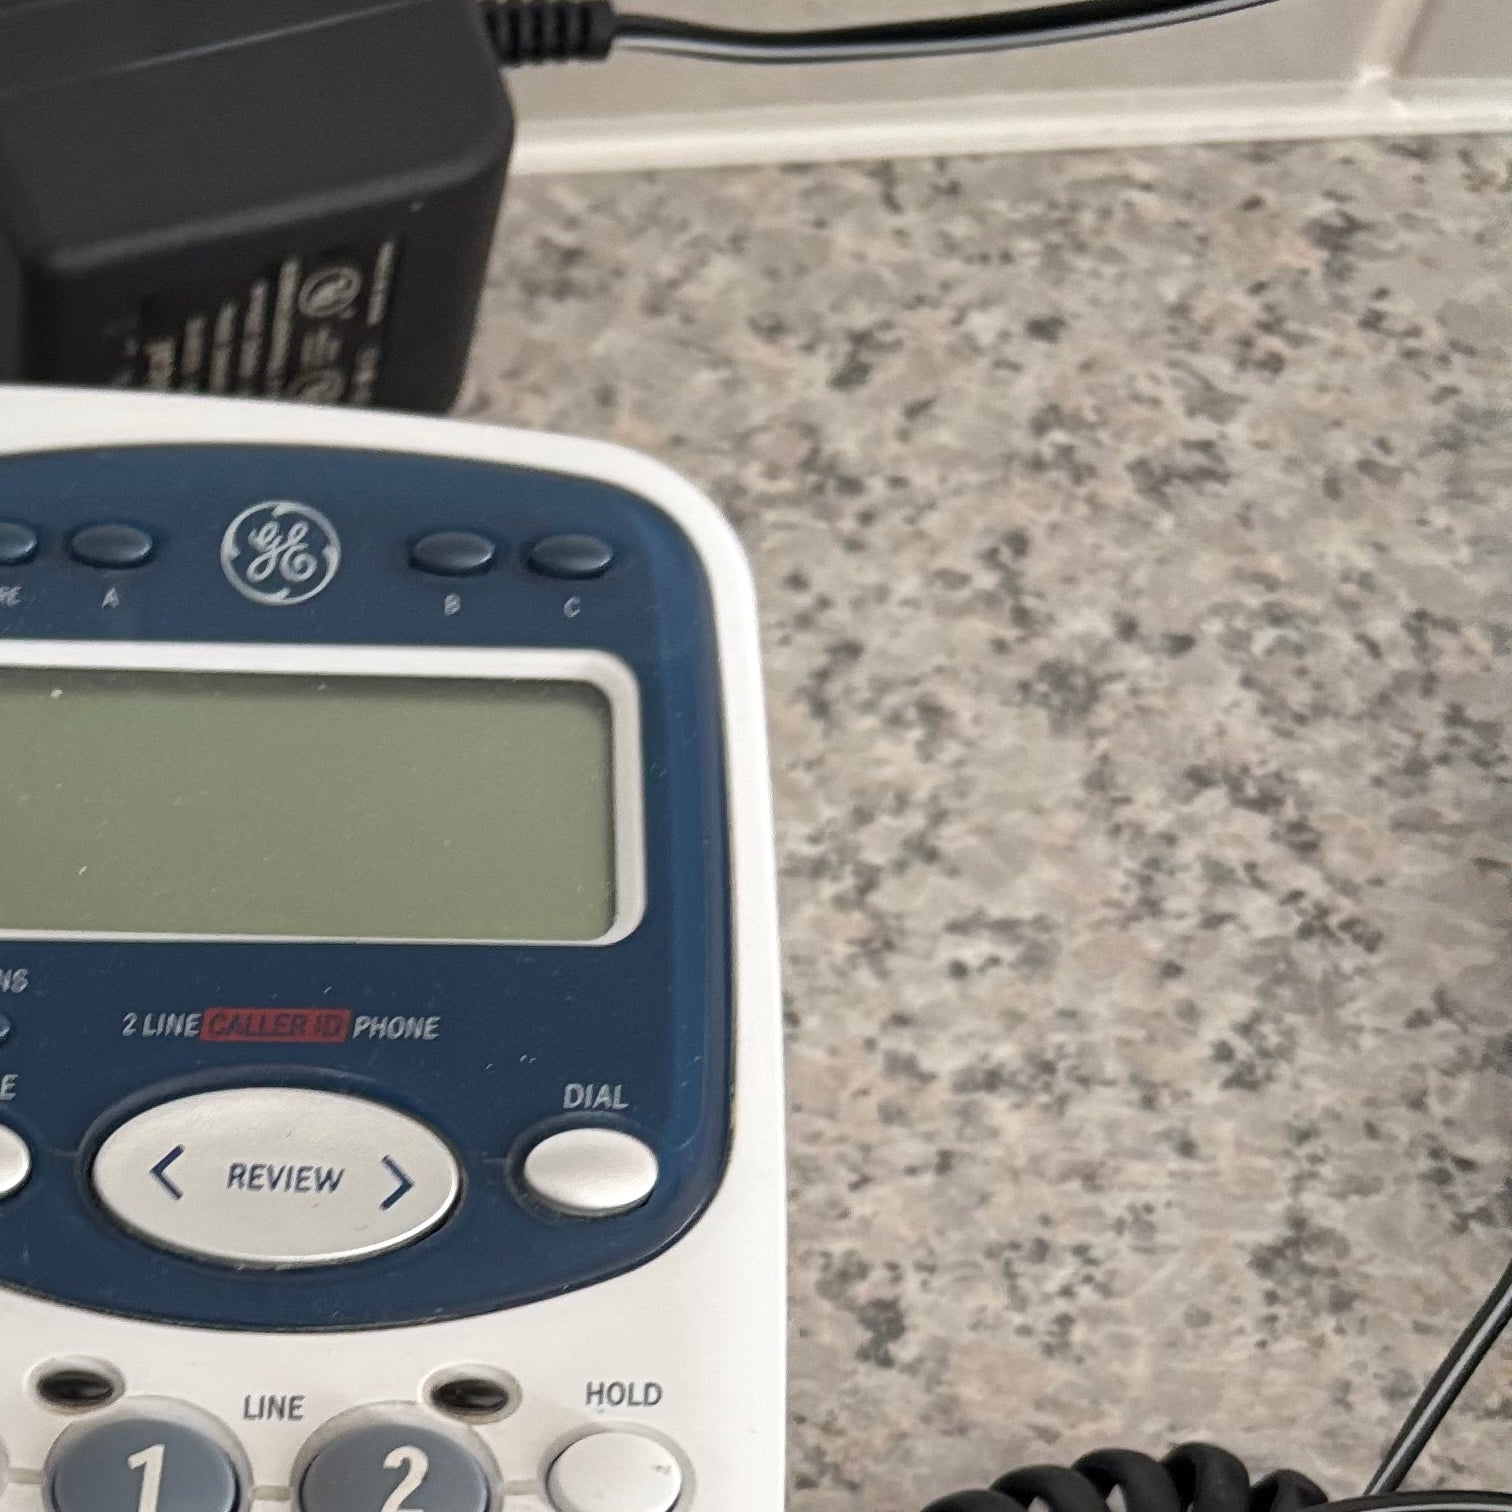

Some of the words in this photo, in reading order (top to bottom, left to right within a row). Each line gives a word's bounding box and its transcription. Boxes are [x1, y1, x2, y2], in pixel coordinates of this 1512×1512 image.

[101, 587, 119, 608] A
[444, 594, 461, 615] B
[563, 597, 581, 618] C
[122, 1012, 138, 1037] 2
[142, 1013, 202, 1037] LINE
[208, 1012, 307, 1038] CALLER
[313, 1013, 343, 1038] ID
[353, 1015, 441, 1040] PHONE
[563, 1083, 629, 1109] DIAL
[226, 1162, 345, 1193] REVIEW
[585, 1381, 663, 1407] HOLD
[243, 1395, 305, 1421] LINE
